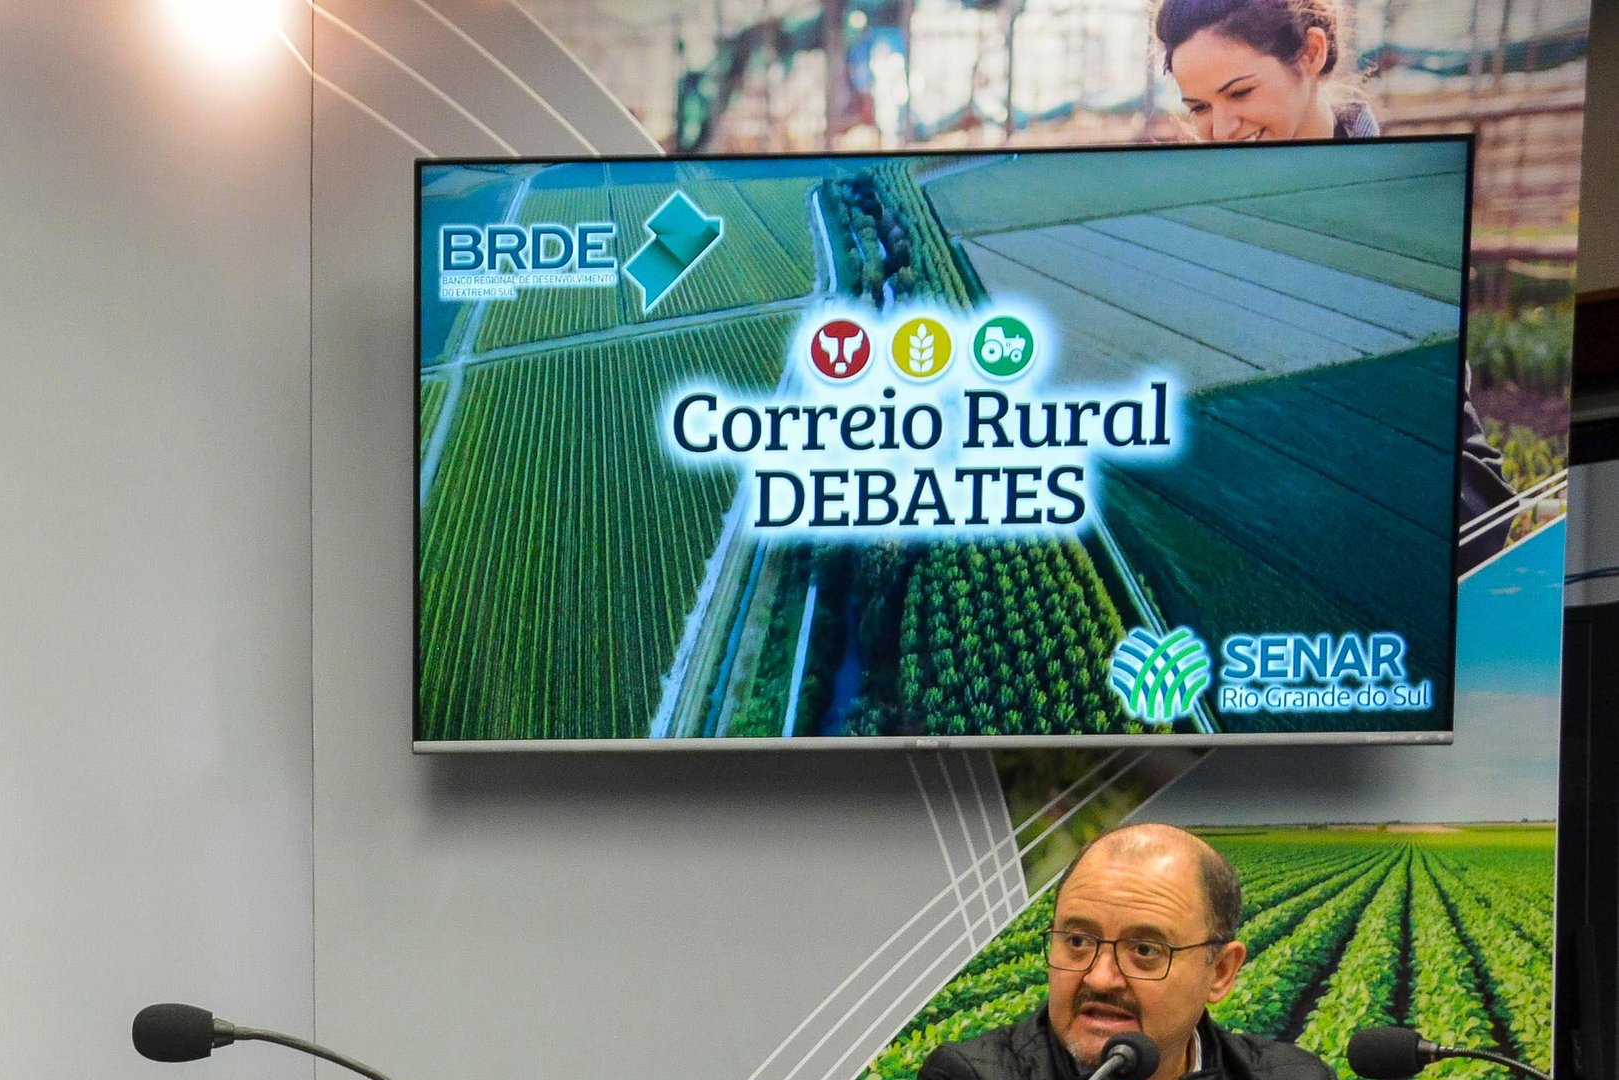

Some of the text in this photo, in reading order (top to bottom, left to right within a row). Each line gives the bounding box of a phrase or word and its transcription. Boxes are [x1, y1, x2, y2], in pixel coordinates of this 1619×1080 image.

[442, 225, 615, 271] BRDE
[442, 274, 615, 285] BANCO REGIONAL DE DESENVOLVIMENTO
[442, 287, 515, 297] DO EXTREMO SUL
[673, 382, 1171, 453] Correio Rural
[754, 465, 1086, 528] DEBATES
[1223, 636, 1404, 679] SENAR
[1222, 684, 1430, 708] Rio Grande do Sul
